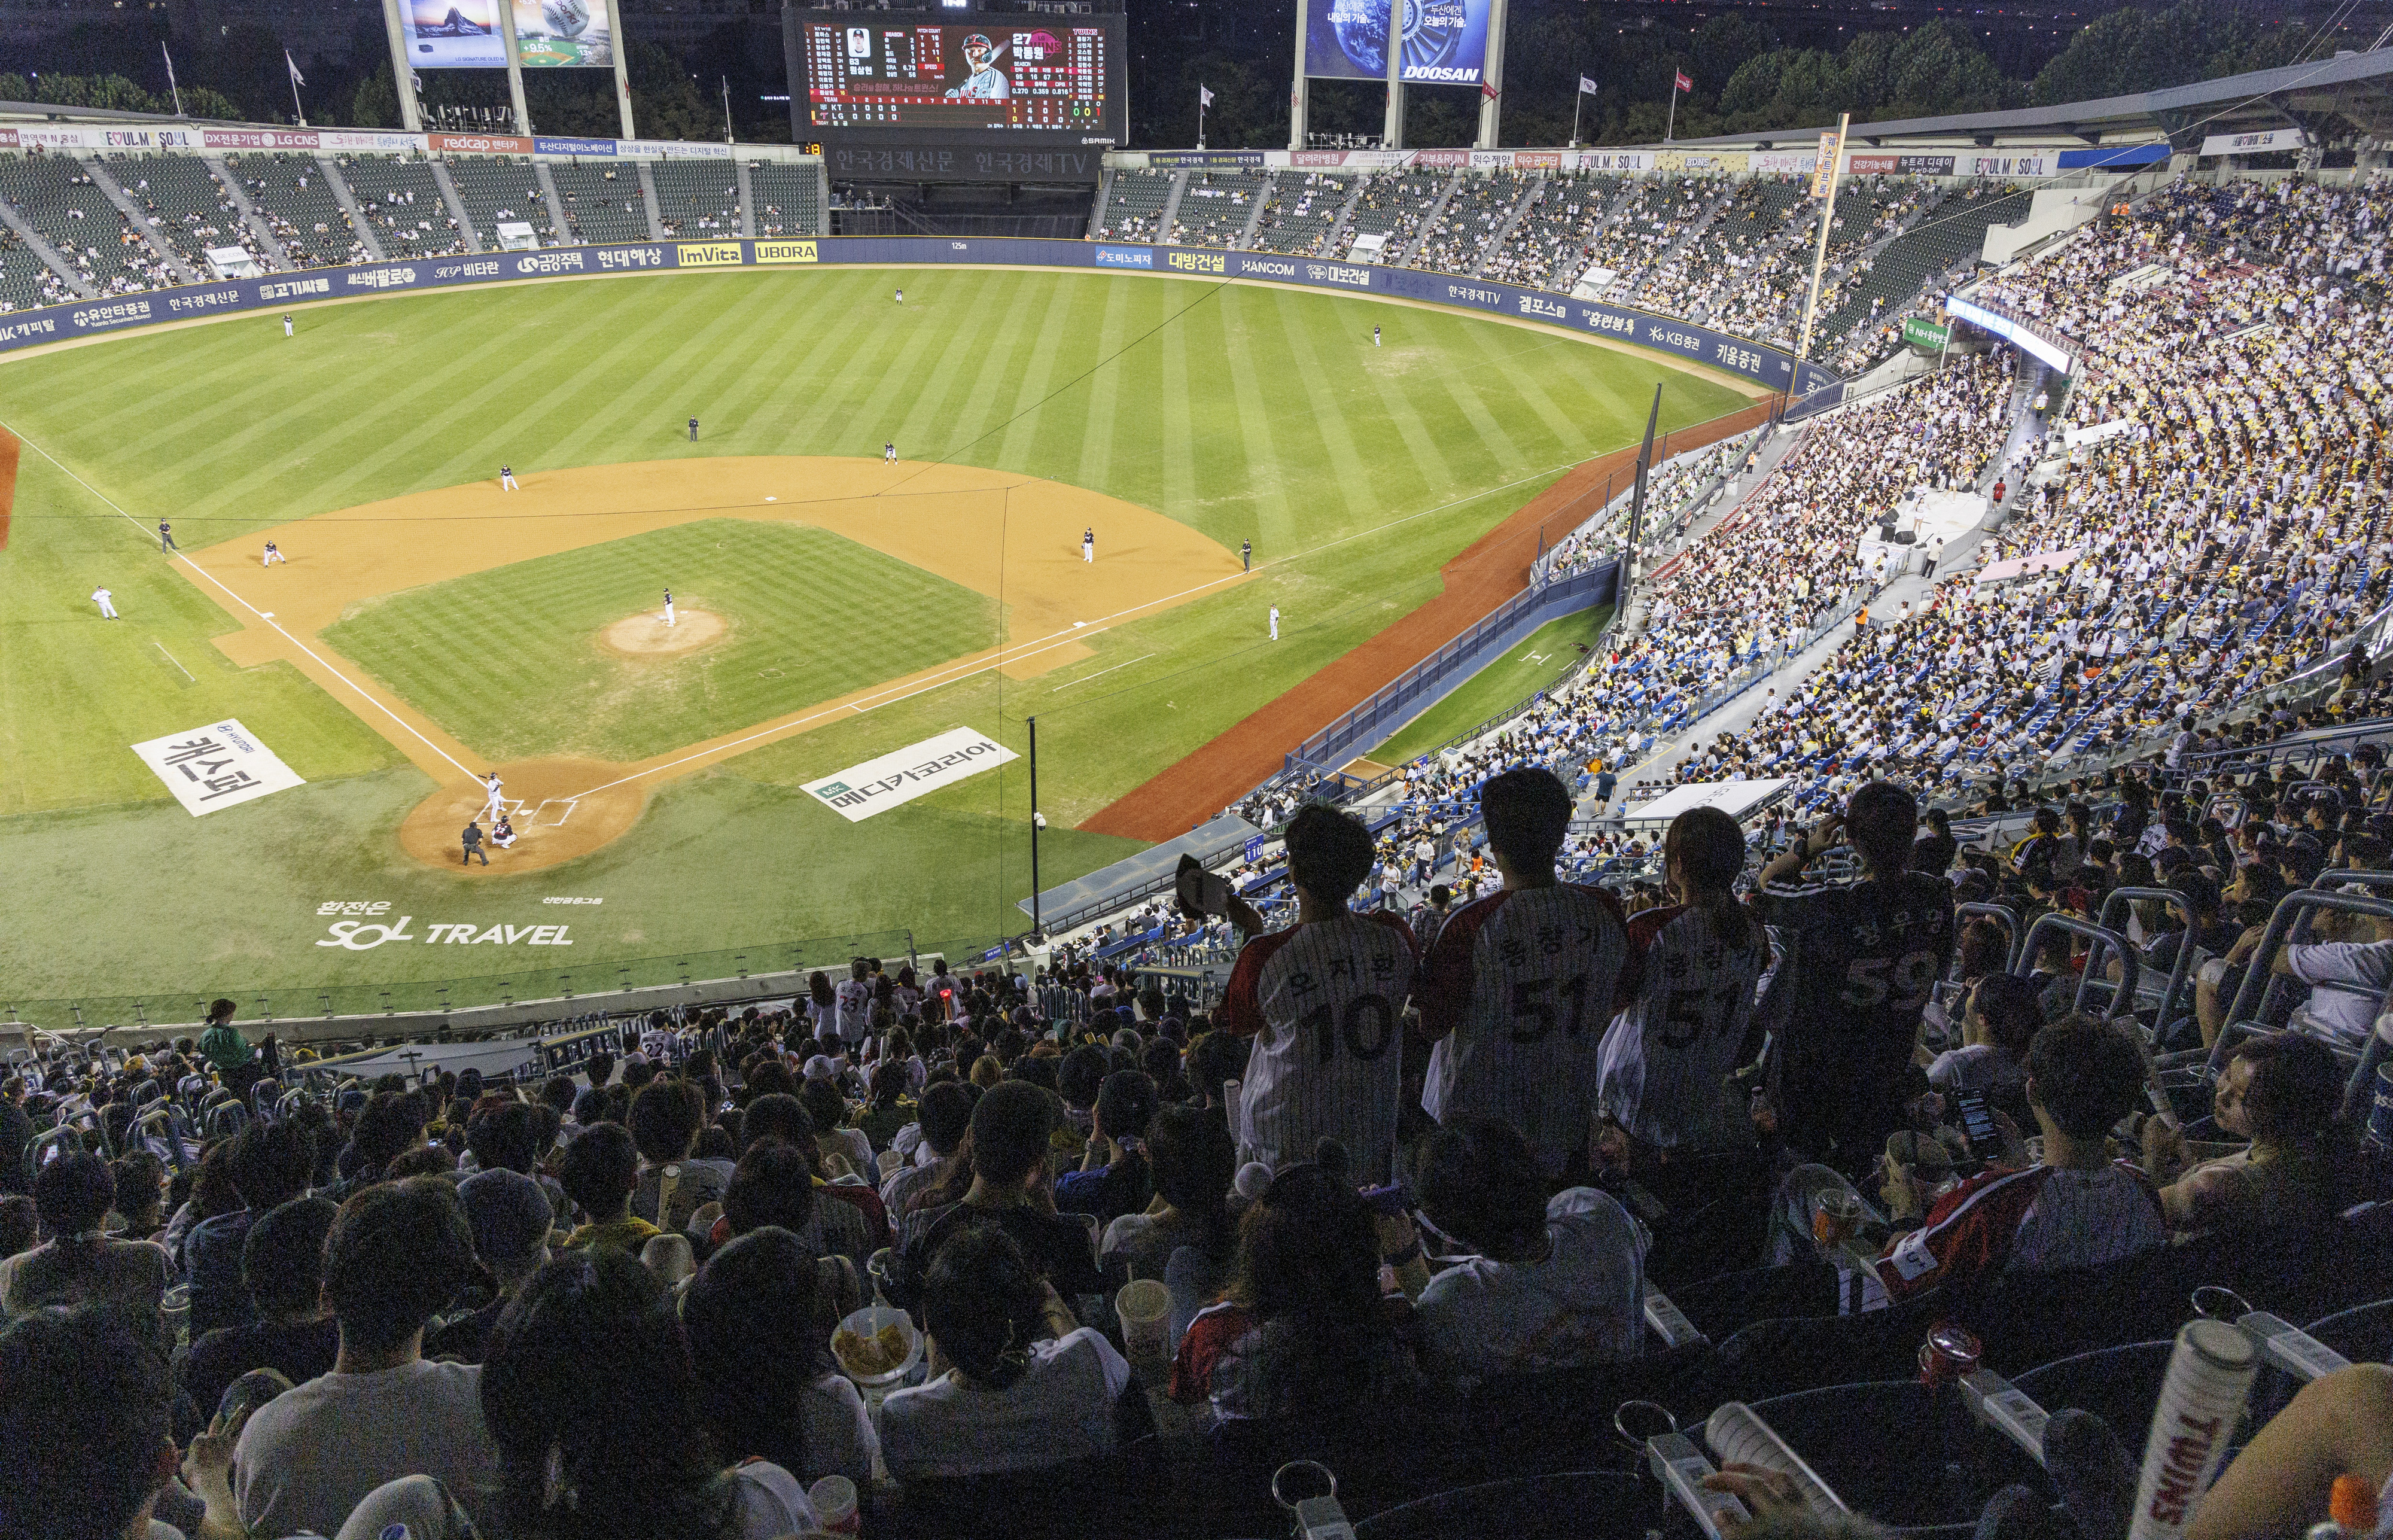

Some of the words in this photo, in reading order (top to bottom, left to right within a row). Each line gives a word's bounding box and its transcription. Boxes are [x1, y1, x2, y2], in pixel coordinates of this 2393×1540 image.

[1333, 1, 1365, 12] 세상에겐
[1430, 4, 1462, 16] 두산에겐
[1327, 12, 1350, 23] 내일의
[1351, 13, 1370, 24] 기술.
[1424, 15, 1447, 27] 오늘의
[1448, 16, 1466, 28] 기술.
[1013, 34, 1032, 45] 27
[1013, 47, 1044, 59] 박동원
[1403, 66, 1479, 81] DOOSAN
[20, 133, 48, 143] 면역력
[205, 135, 260, 145] DX전문기업
[278, 136, 295, 145] LG
[296, 136, 318, 145] CNS
[444, 137, 490, 151] redcap
[492, 139, 518, 150] 렌터카
[540, 142, 613, 153] 두산디지털이노베이션
[620, 145, 641, 153] 상상을
[643, 145, 664, 154] 현실로
[666, 146, 688, 156] 만드는
[690, 147, 711, 156] 디지털
[713, 147, 727, 156] 혁신
[837, 150, 955, 173] 한국경제신문
[975, 152, 1088, 174] 한국경제TV
[1296, 154, 1339, 165] 달려라병원
[1420, 154, 1465, 165] 기부&RUN
[1473, 155, 1511, 165] 익수제약
[1685, 157, 1709, 168] BDNS
[1819, 137, 1837, 194] 웨스트프롬
[1853, 160, 1893, 169] 건강기능식품
[1901, 157, 1925, 168] 뉴트리
[1928, 157, 1953, 167] 디데이
[598, 248, 662, 268] 현대해상
[757, 246, 816, 258] UBORA
[1106, 252, 1152, 266] 도미노피자
[463, 261, 499, 276] 비타란
[539, 252, 583, 272] 금강주택
[1169, 252, 1225, 273] 대방건설
[1242, 260, 1294, 276] HANCOM
[1329, 266, 1370, 285] 대보건설
[274, 278, 330, 298] 고기싸롱
[1448, 285, 1501, 305] 한국경제TV
[169, 290, 239, 311] 한국경제신문
[1519, 296, 1557, 317] 겔포스
[88, 301, 150, 319] 유안타증권
[17, 319, 55, 336] 캐피탈
[90, 318, 109, 328] Yuanta
[1589, 311, 1625, 331] 홈런볼
[1717, 343, 1761, 373] 키움증권
[226, 732, 255, 754] HYUNDAI
[163, 736, 262, 802] 캐스퍼
[830, 741, 997, 808] 메디카코리아
[1246, 843, 1263, 860] 110
[316, 900, 392, 915] 환전은
[315, 916, 413, 950] SOL
[425, 923, 574, 945] TRAVEL
[1840, 951, 1937, 1011] 59
[1512, 973, 1587, 1043] 51
[1660, 983, 1740, 1048] 51
[1301, 994, 1392, 1064] 10
